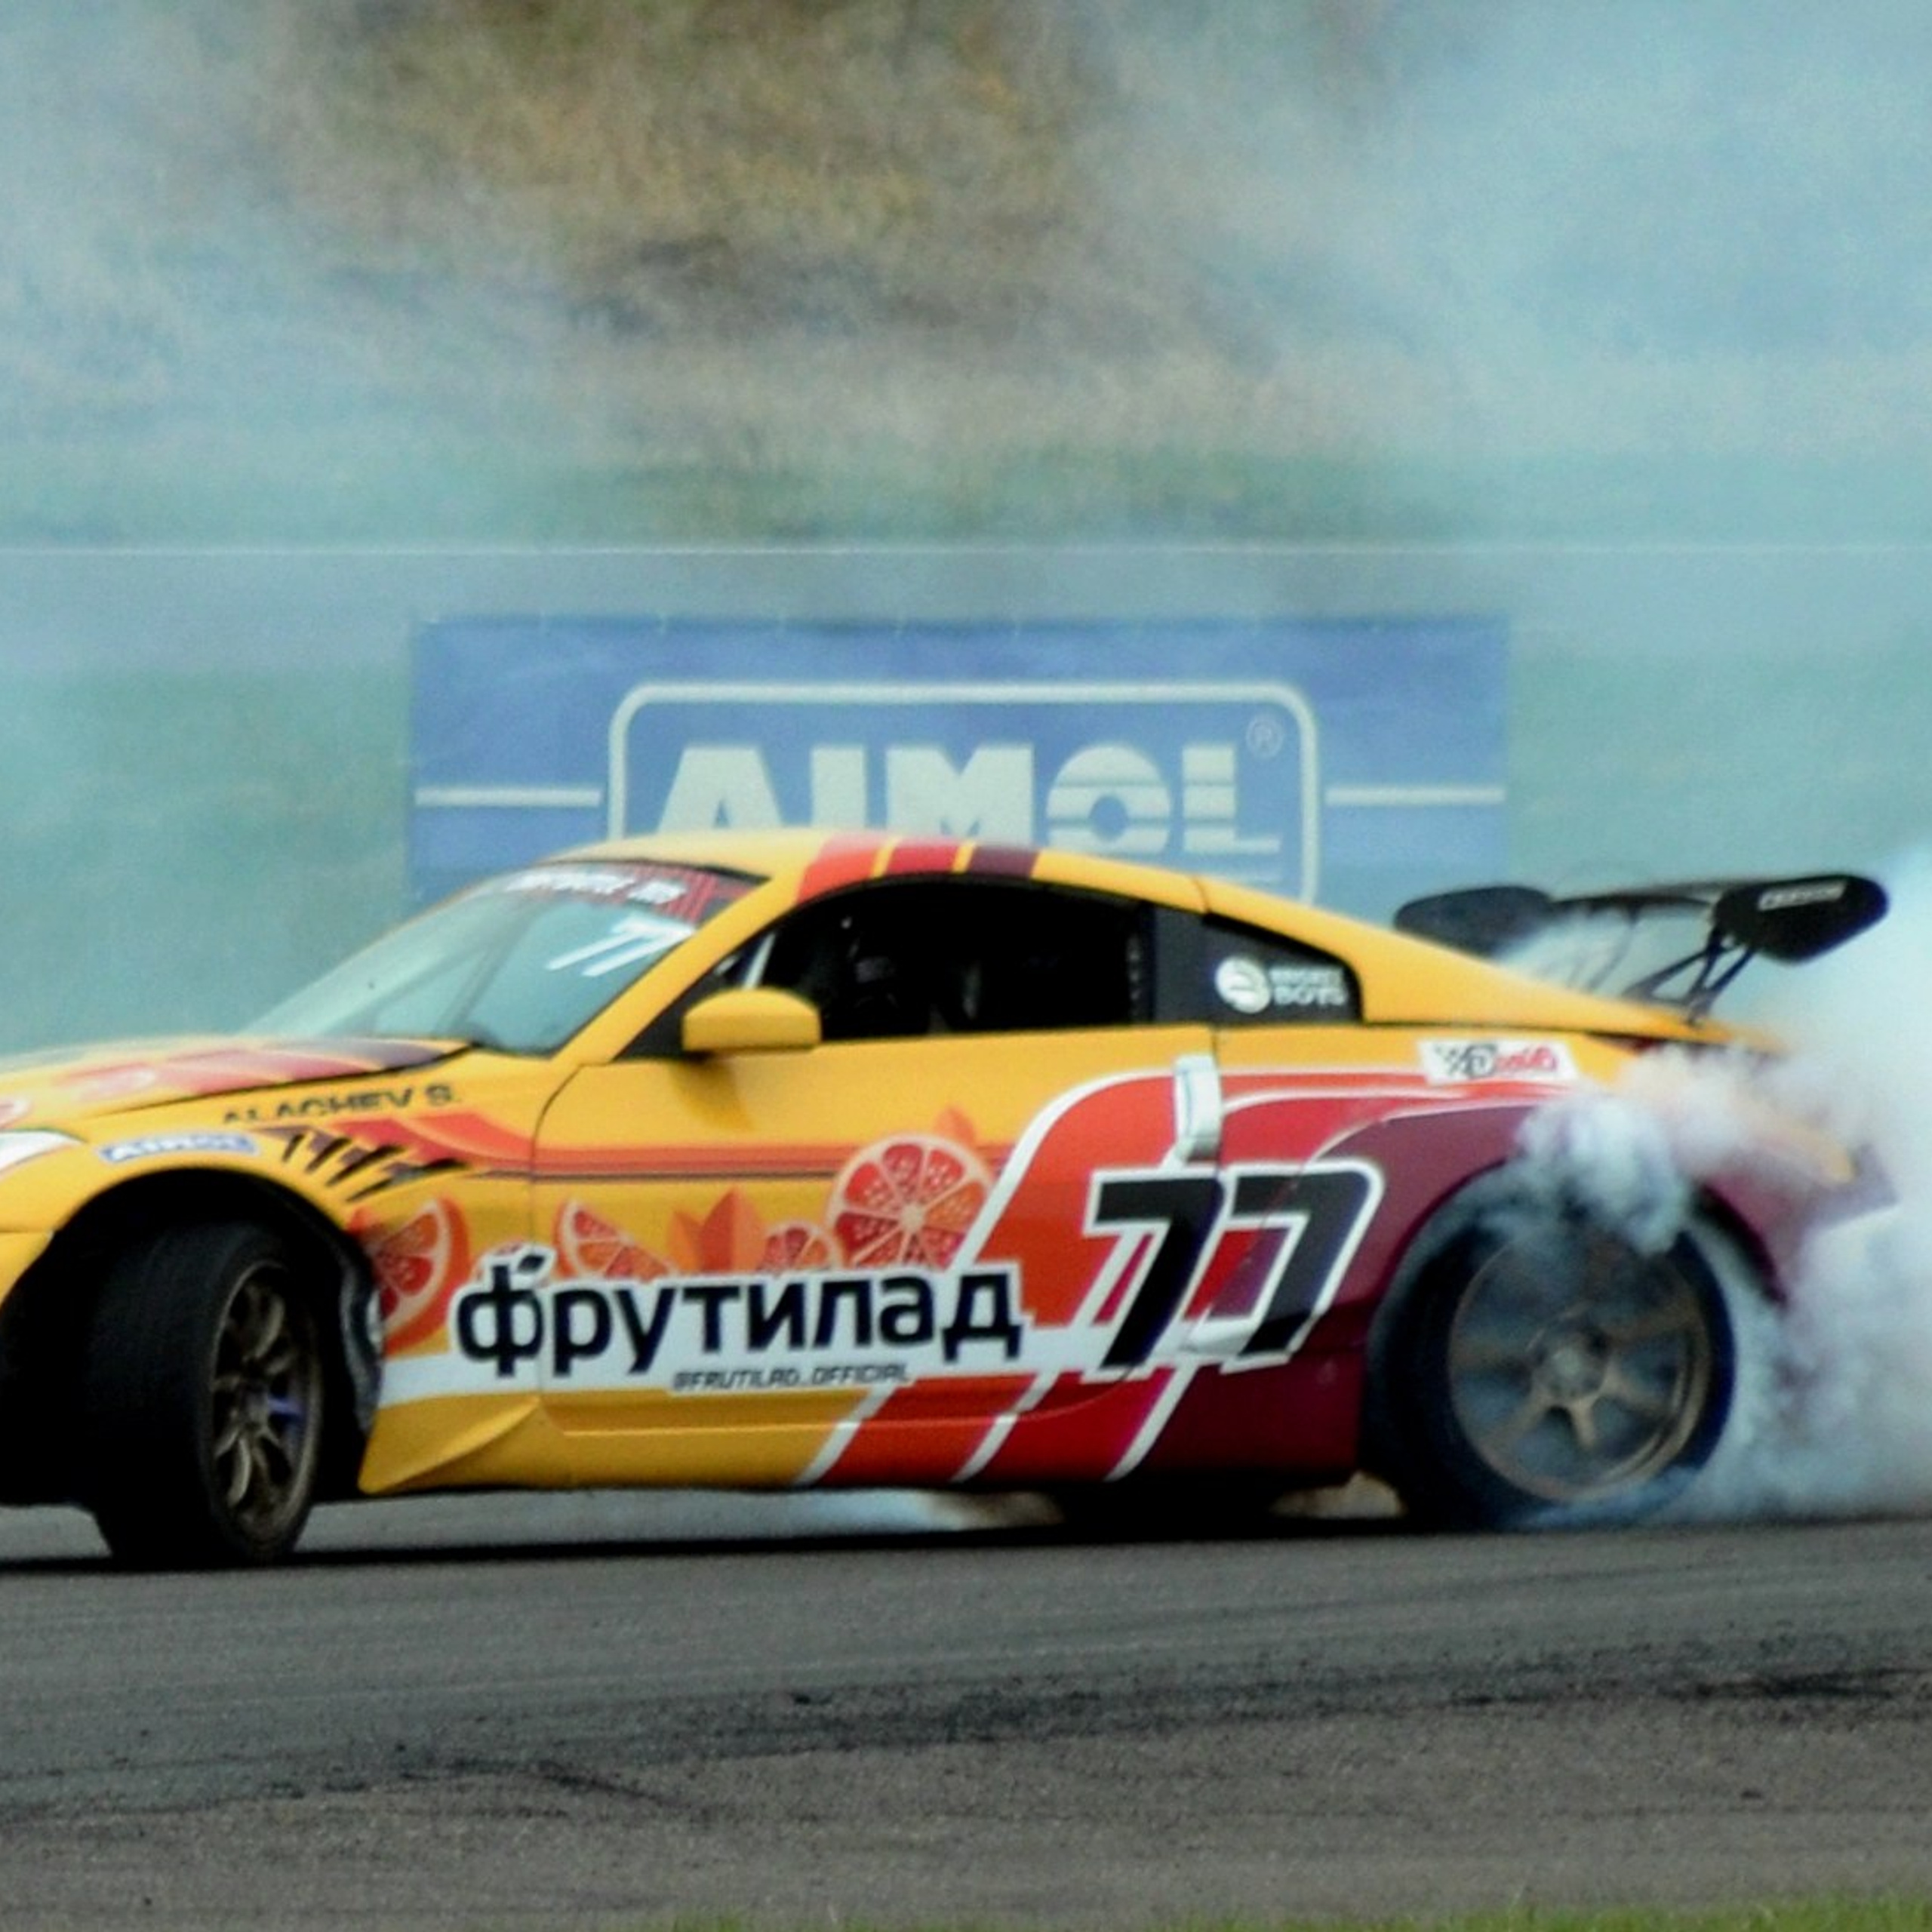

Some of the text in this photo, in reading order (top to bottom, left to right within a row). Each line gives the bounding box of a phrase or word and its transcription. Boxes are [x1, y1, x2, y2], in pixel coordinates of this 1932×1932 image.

[655, 743, 1281, 868] AIMOL
[456, 1259, 1023, 1376] фрутилад
[1091, 1169, 1373, 1371] 77
